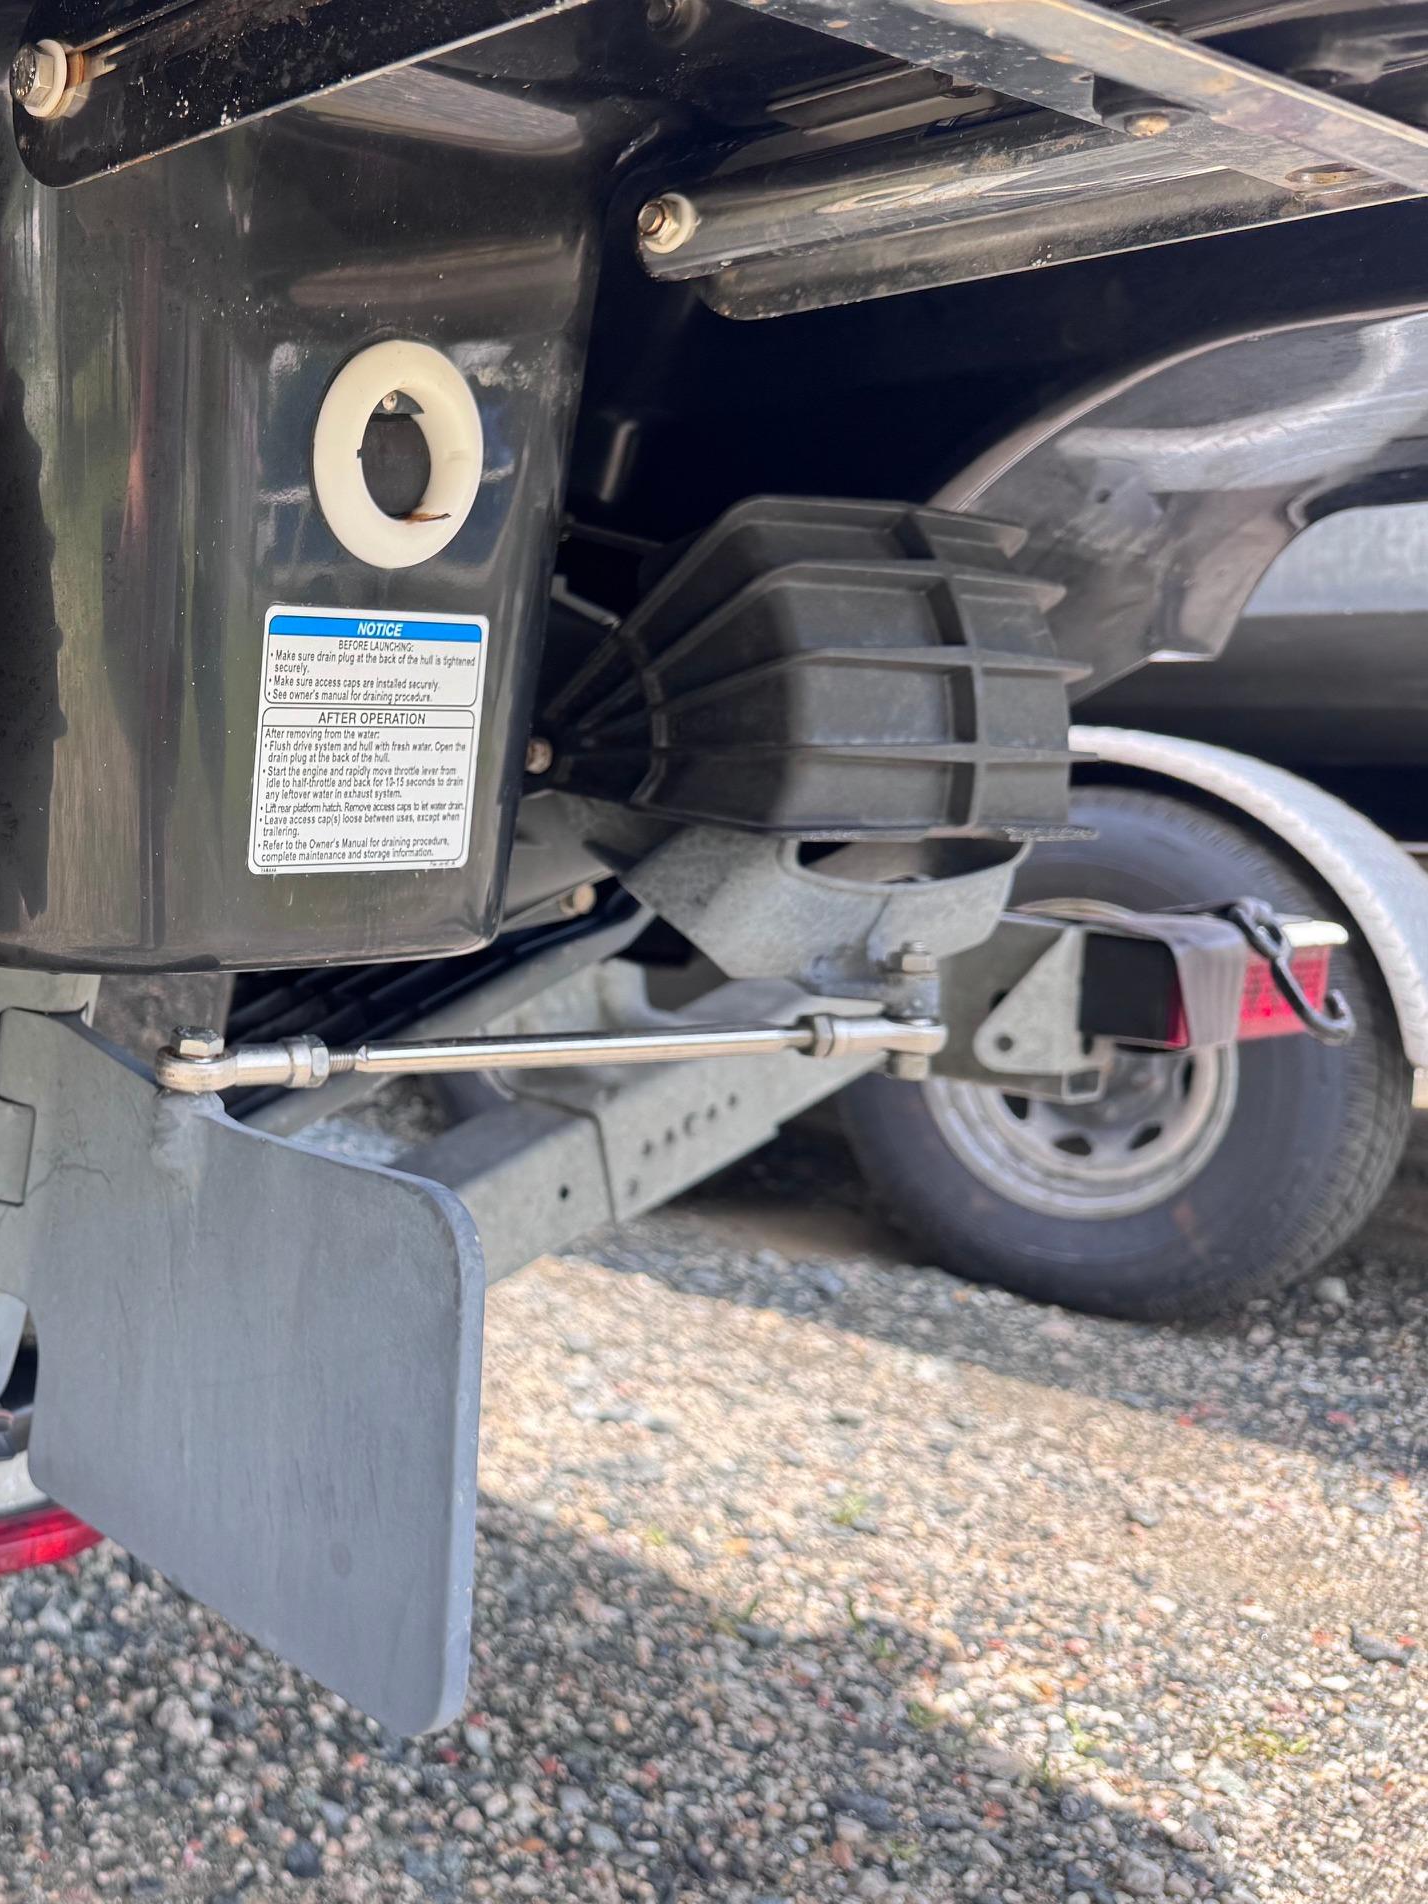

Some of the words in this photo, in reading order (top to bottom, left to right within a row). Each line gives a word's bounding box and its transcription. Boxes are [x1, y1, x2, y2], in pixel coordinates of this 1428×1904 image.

[357, 622, 403, 636] NOTICE
[338, 640, 368, 650] BEFORE
[370, 641, 414, 652] LAUNCHING:
[275, 650, 295, 661] Make
[298, 653, 314, 661] sure
[317, 651, 335, 662] drain
[338, 652, 354, 665] plug
[357, 654, 363, 662] at
[366, 654, 377, 663] the
[379, 654, 395, 664] back
[398, 655, 406, 664] of
[407, 655, 418, 664] the
[435, 655, 441, 665] is
[275, 663, 309, 675] securely.
[274, 675, 293, 686] Make
[296, 678, 312, 686] sure
[315, 679, 340, 687] access
[343, 680, 360, 688] caps
[363, 680, 374, 688] are
[376, 677, 406, 688] installed
[273, 689, 286, 699] See
[290, 690, 319, 700] owner's
[322, 691, 348, 700] manual
[351, 691, 360, 700] for
[363, 691, 392, 704] draining
[318, 712, 356, 724] AFTER
[360, 712, 425, 724] OPERATION
[265, 728, 284, 738] After
[286, 729, 322, 741] removing
[325, 729, 341, 738] from
[344, 730, 354, 738] the
[358, 731, 380, 739] water:
[270, 741, 290, 751] Flush
[293, 741, 312, 751] drive
[315, 742, 341, 755] system
[343, 742, 357, 751] and
[359, 742, 372, 751] hull
[375, 742, 389, 751] with
[392, 741, 410, 751] fresh
[412, 743, 432, 751] water.
[435, 742, 453, 753] Open
[268, 753, 287, 762] drain
[290, 753, 307, 765] plug
[309, 754, 316, 762] at
[319, 753, 330, 762] the
[332, 753, 349, 762] back
[352, 753, 359, 762] of
[361, 753, 372, 762] the
[375, 753, 389, 762] hull.
[268, 766, 286, 776] Start
[289, 766, 300, 776] the
[303, 767, 327, 778] engine
[330, 766, 343, 776] and
[346, 766, 370, 779] rapidly
[394, 766, 419, 775] throttle
[267, 778, 280, 787] idle
[283, 778, 290, 787] to
[293, 778, 335, 787] half-throttle
[338, 778, 351, 786] and
[354, 778, 370, 786] back
[373, 777, 383, 787] for
[406, 778, 435, 786] seconds
[437, 777, 444, 786] to
[266, 791, 279, 802] any
[282, 789, 310, 799] leftover
[313, 790, 333, 799] water
[335, 789, 341, 798] in
[344, 790, 372, 799] exhaust
[375, 790, 402, 800] system.
[266, 803, 276, 813] Lift
[278, 805, 291, 813] rear
[293, 803, 320, 814] platform
[322, 802, 342, 812] hatch.
[344, 802, 371, 811] Remove
[373, 803, 394, 811] access
[397, 804, 411, 812] caps
[265, 815, 286, 824] Leave
[290, 816, 315, 824] access
[318, 814, 341, 826] cap(s)
[343, 814, 362, 823] loose
[365, 814, 394, 823] between
[397, 815, 414, 823] uses,
[263, 826, 299, 838] trailering.
[263, 841, 283, 850] Refer
[286, 841, 293, 849] to
[296, 839, 307, 849] the
[309, 839, 339, 849] Owner's
[342, 838, 368, 848] Manual
[370, 838, 380, 847] for
[382, 837, 410, 848] draining
[262, 851, 296, 862] complete
[299, 851, 346, 860] maintenance
[348, 850, 361, 859] and
[364, 850, 390, 860] storage
[392, 848, 433, 857] information.
